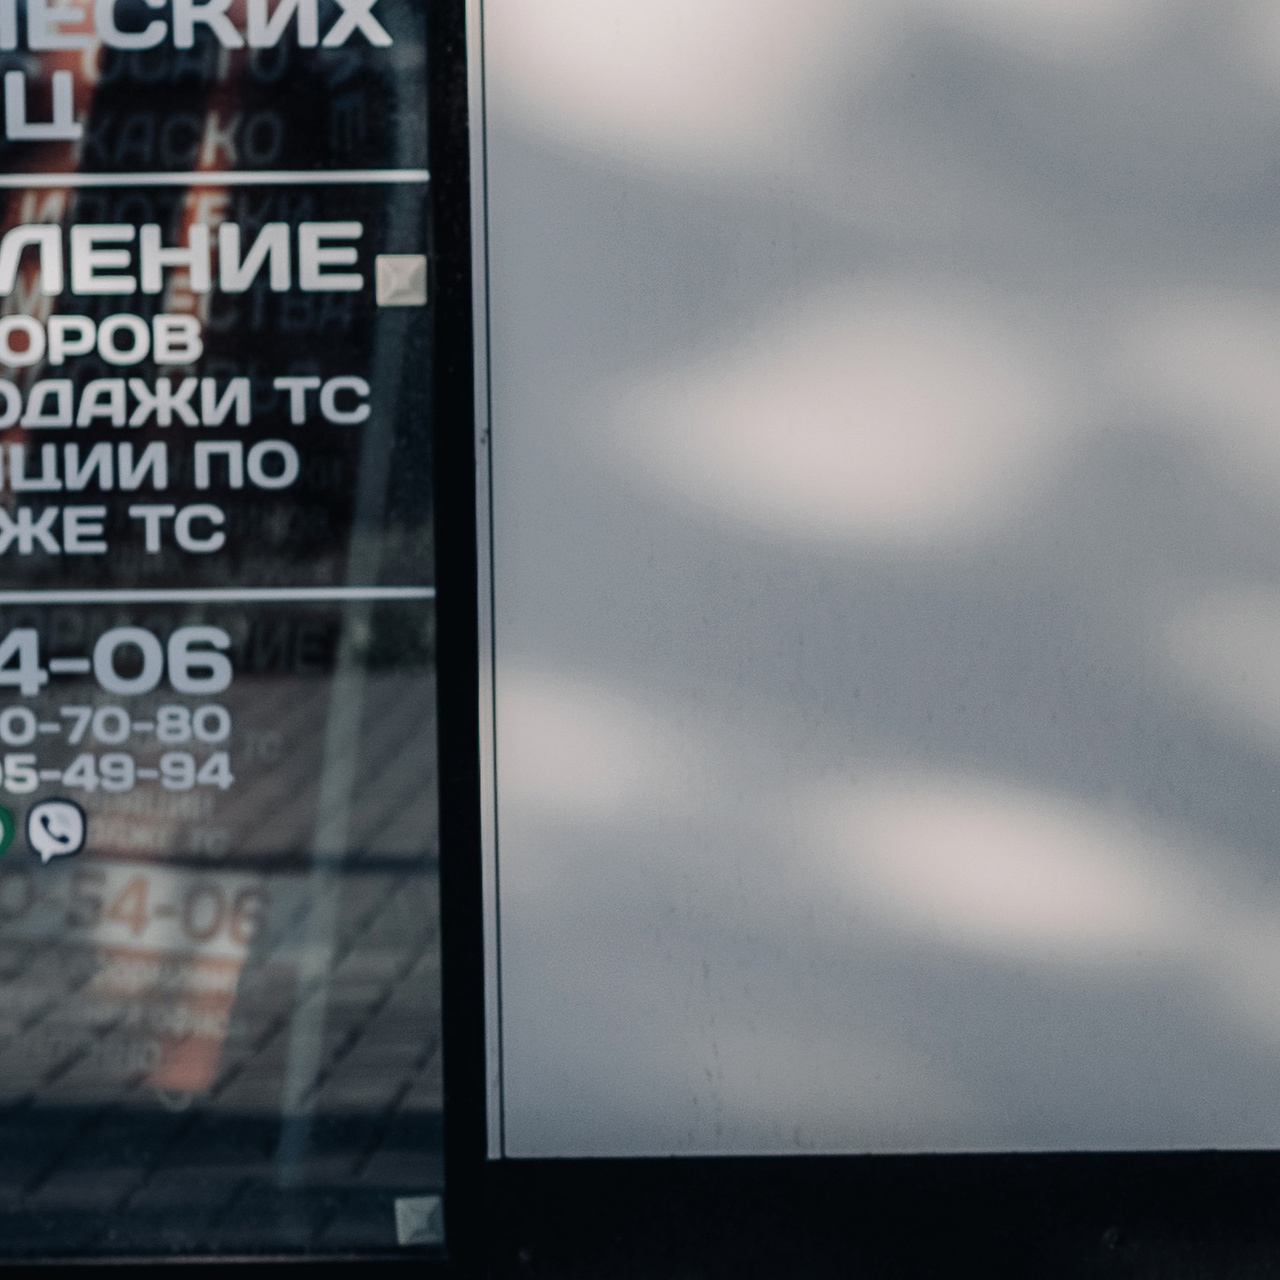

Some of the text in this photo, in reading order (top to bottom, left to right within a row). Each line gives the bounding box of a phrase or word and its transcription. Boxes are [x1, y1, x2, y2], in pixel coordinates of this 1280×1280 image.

[0, 220, 365, 297] ЛЕНИЕ
[0, 313, 205, 367] ОРОВ
[272, 375, 372, 425] ТС
[0, 439, 301, 492] ЦИИ ПО
[128, 503, 227, 553] ТС
[0, 625, 233, 697] 4-06
[0, 703, 232, 746] 0-70-80
[0, 751, 235, 794] 5-49-94
